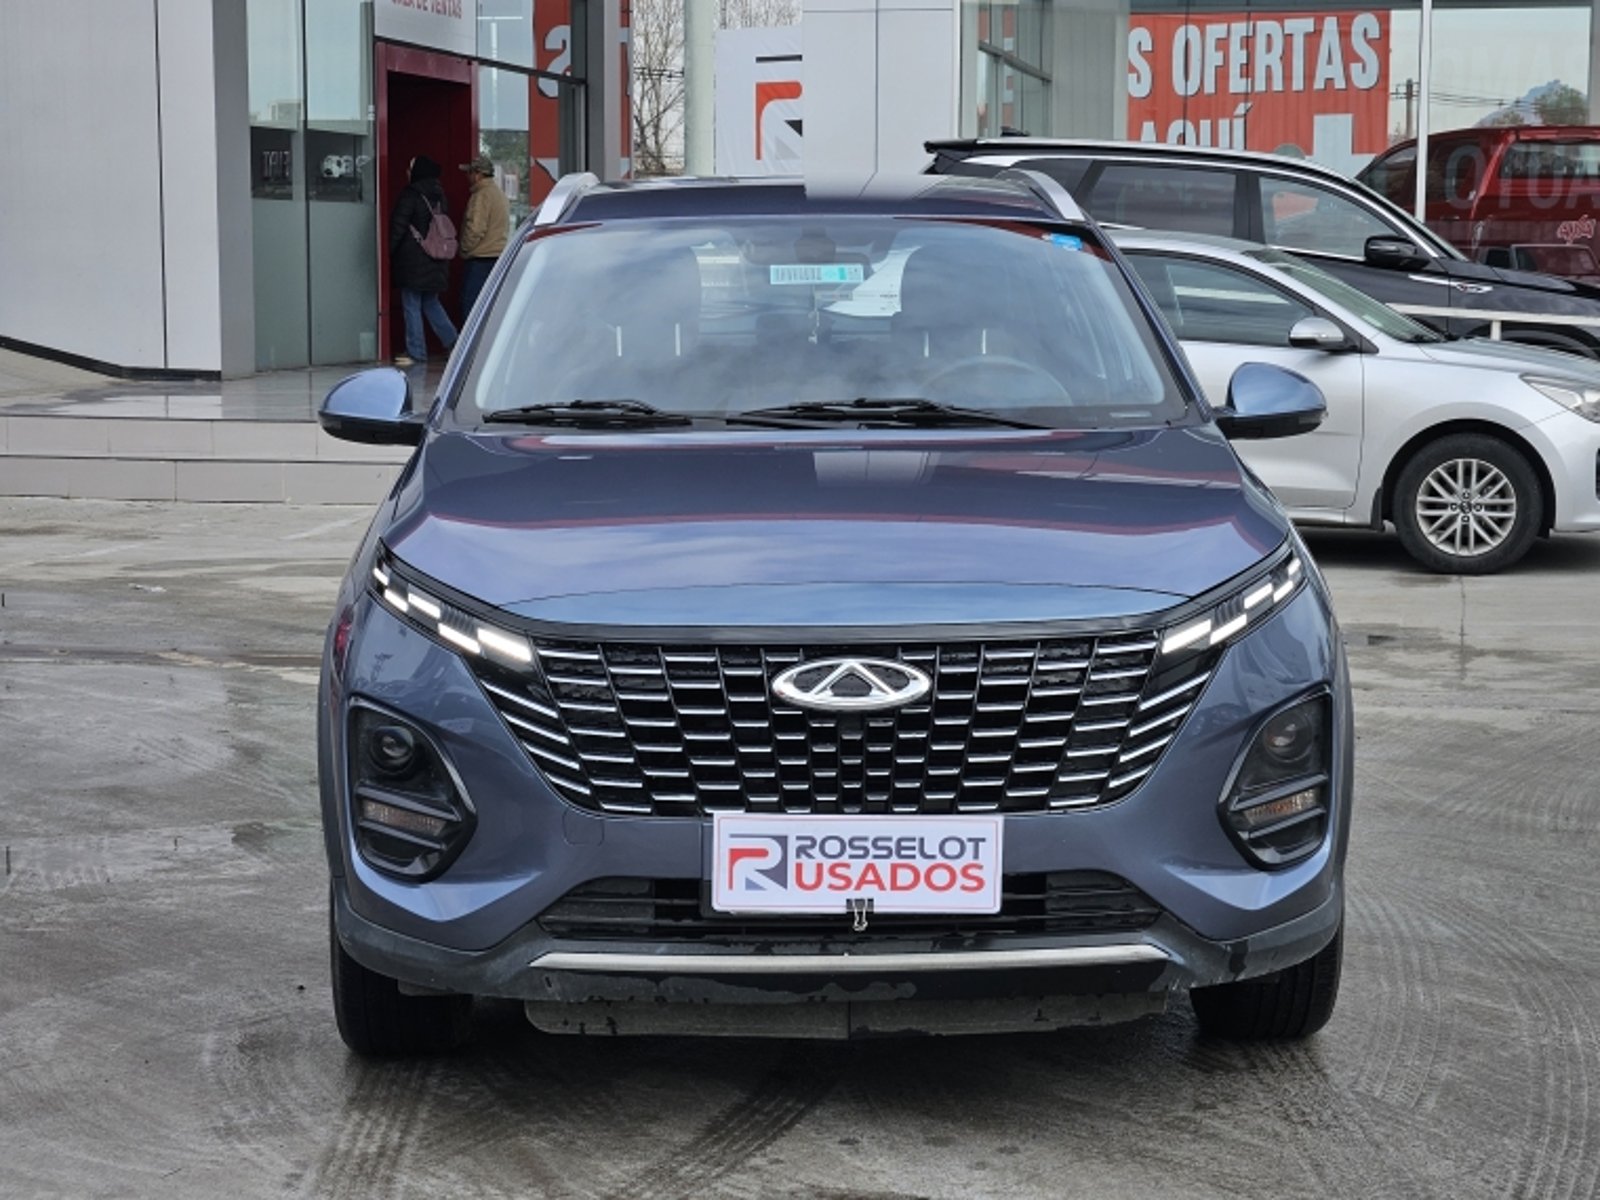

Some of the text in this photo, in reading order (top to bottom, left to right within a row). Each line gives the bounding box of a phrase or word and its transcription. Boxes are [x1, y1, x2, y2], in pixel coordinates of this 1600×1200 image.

[1172, 12, 1380, 97] OFERTAS
[795, 835, 986, 860] ROSSELOT
[795, 862, 985, 893] USADOS
